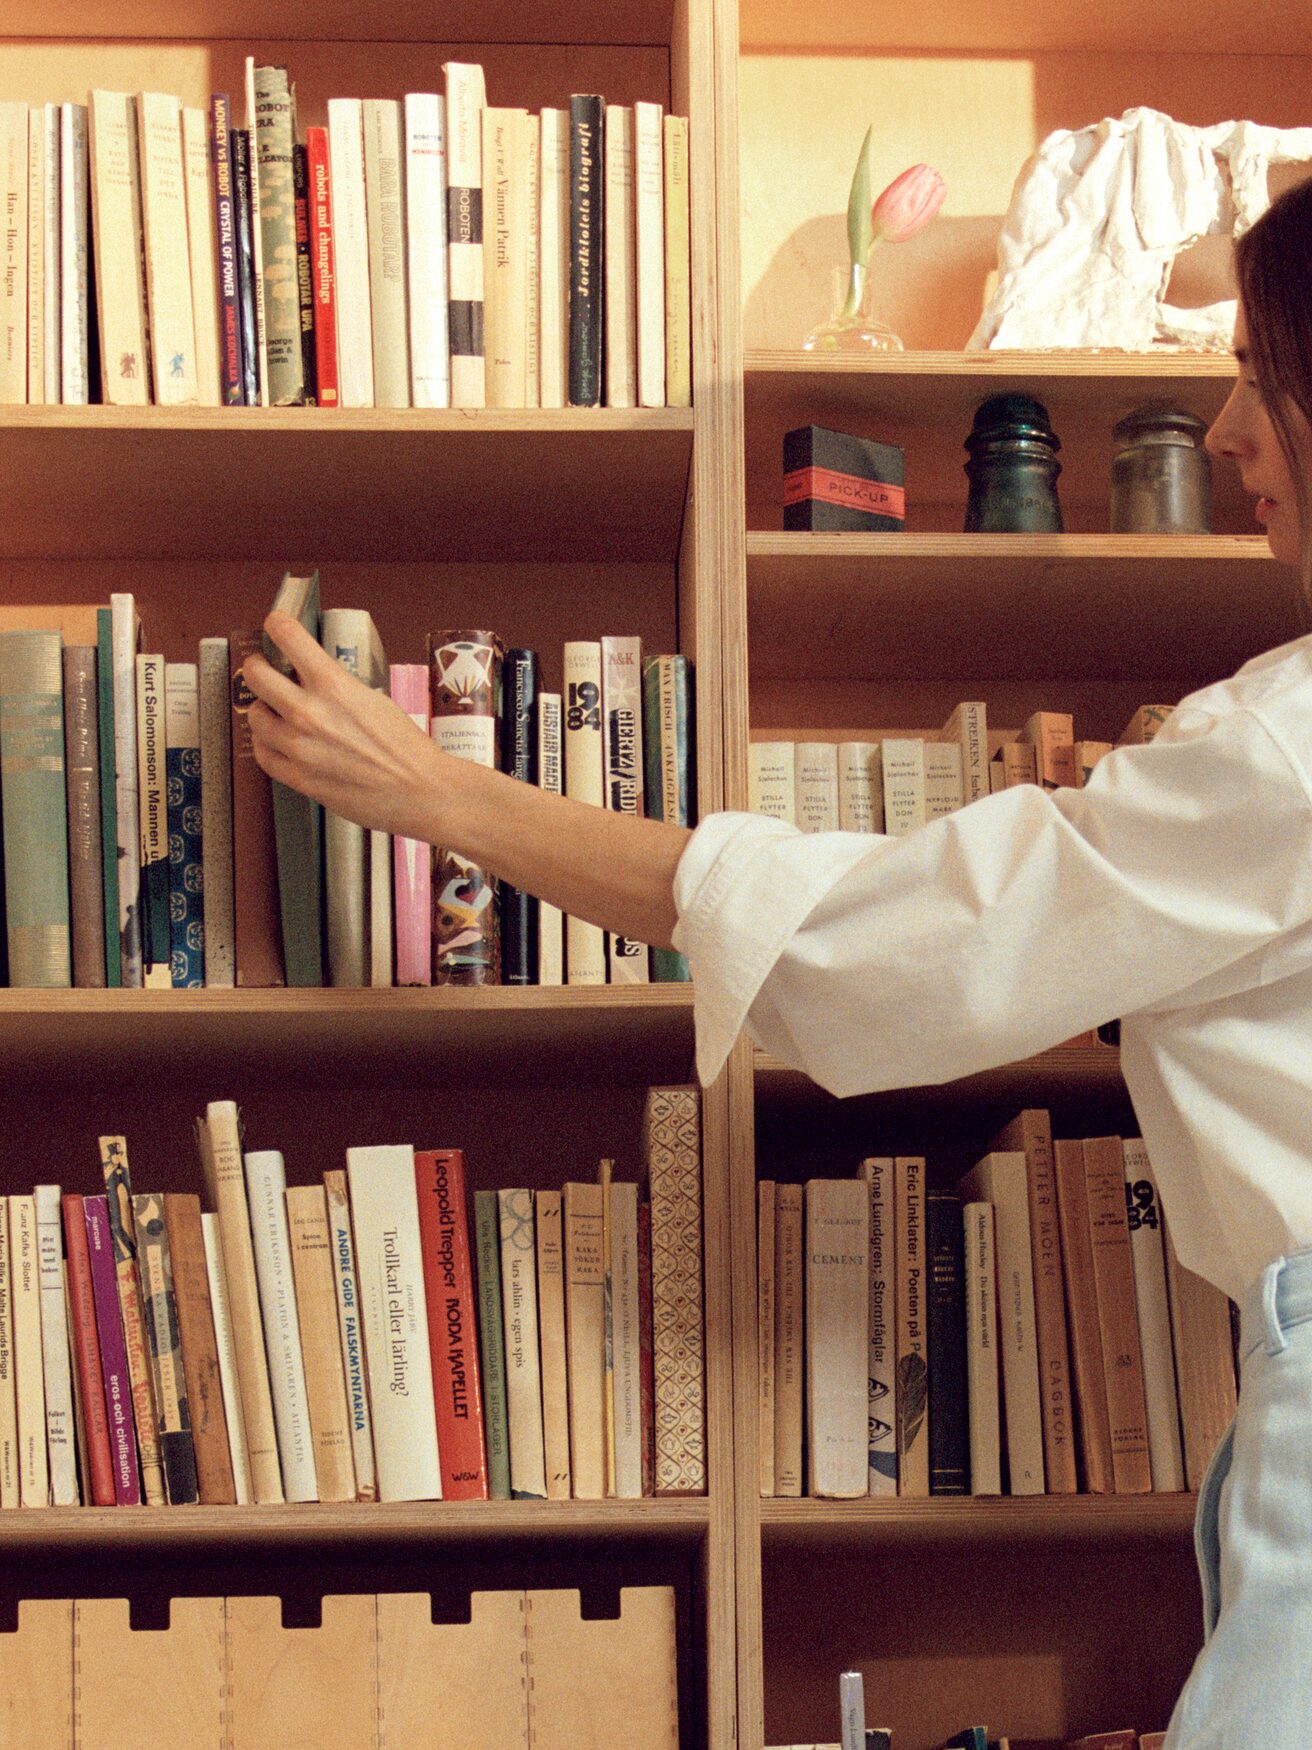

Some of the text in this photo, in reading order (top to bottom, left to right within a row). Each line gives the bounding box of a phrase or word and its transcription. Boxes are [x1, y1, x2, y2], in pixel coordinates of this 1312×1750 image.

[215, 100, 234, 297] MONKEY ROBOT CRYSTAL OF POWER
[316, 165, 332, 303] robots and changelings
[460, 189, 470, 243] ROBOTEN
[497, 180, 508, 268] Vännen Patrik
[5, 265, 17, 297] Ingen
[828, 483, 888, 502] PICK-UP
[515, 660, 531, 710] Francisco
[566, 707, 601, 731] 84
[567, 682, 600, 711] 19
[967, 707, 981, 767] STREJKEN
[144, 663, 161, 846] Kurt Salomonson: Mannen
[90, 1216, 102, 1250] marcuse
[433, 1159, 457, 1287] Leopold Trepper
[813, 1255, 864, 1265] CEMENT
[871, 1166, 886, 1362] Arne Lundgren: Stormfåglar
[907, 1165, 921, 1338] Eric Linklater: Poeten på
[337, 1229, 365, 1429] ANDRÉ GIDE FALSKMYNTARNA
[384, 1227, 409, 1397] Trollkarl eller lärling?
[512, 1260, 525, 1367] lars ahlin egen spis
[1034, 1136, 1066, 1446] PETTER MOEN DAGBOK
[109, 1375, 132, 1487] eros och civilisation
